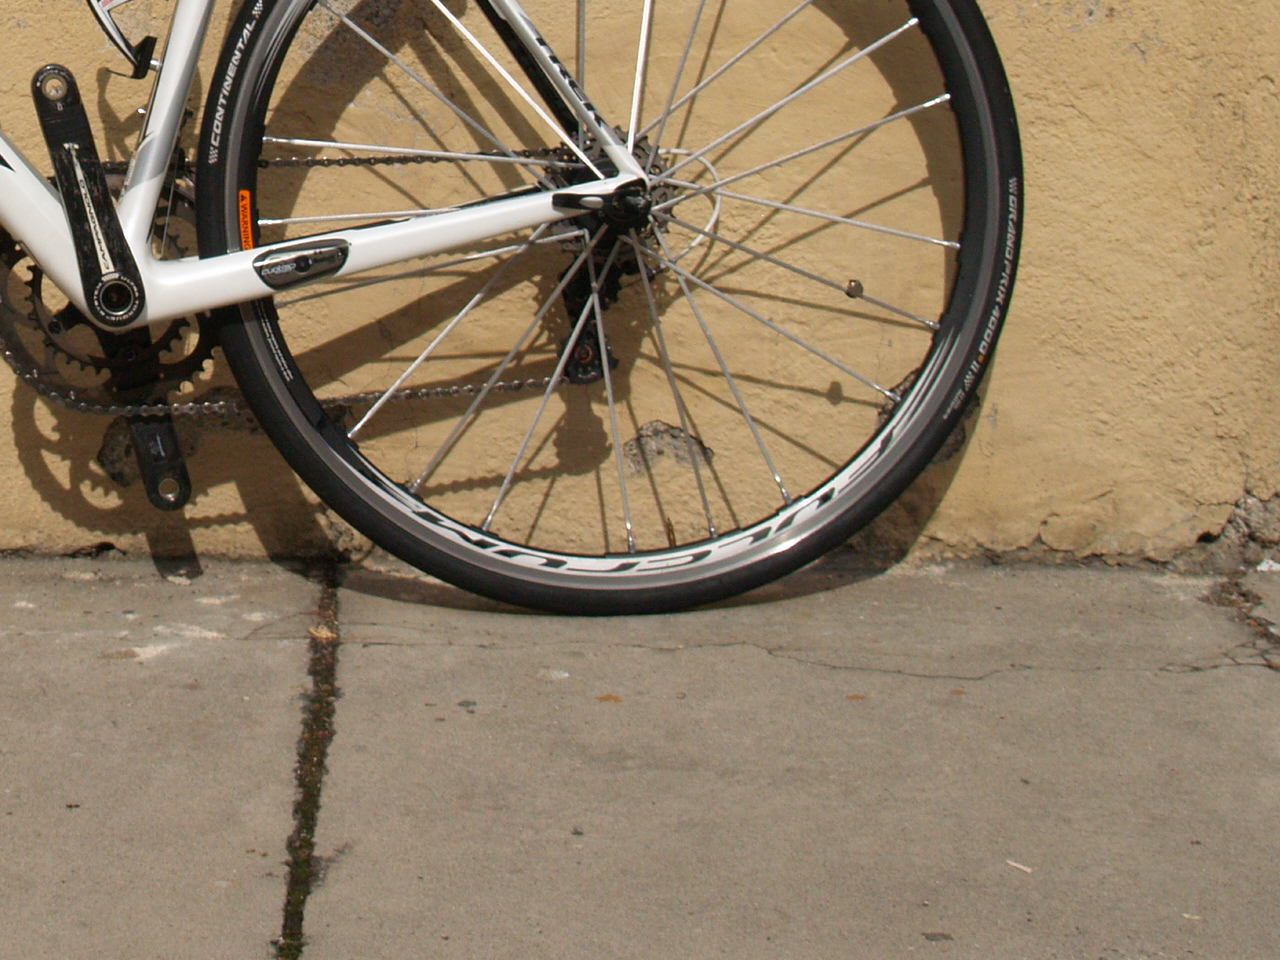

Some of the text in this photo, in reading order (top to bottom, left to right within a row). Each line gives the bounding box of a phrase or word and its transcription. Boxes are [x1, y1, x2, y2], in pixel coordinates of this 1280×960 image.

[211, 18, 257, 147] CONTINENTAL
[995, 260, 1011, 304] PRIX
[978, 304, 1002, 355] 4000
